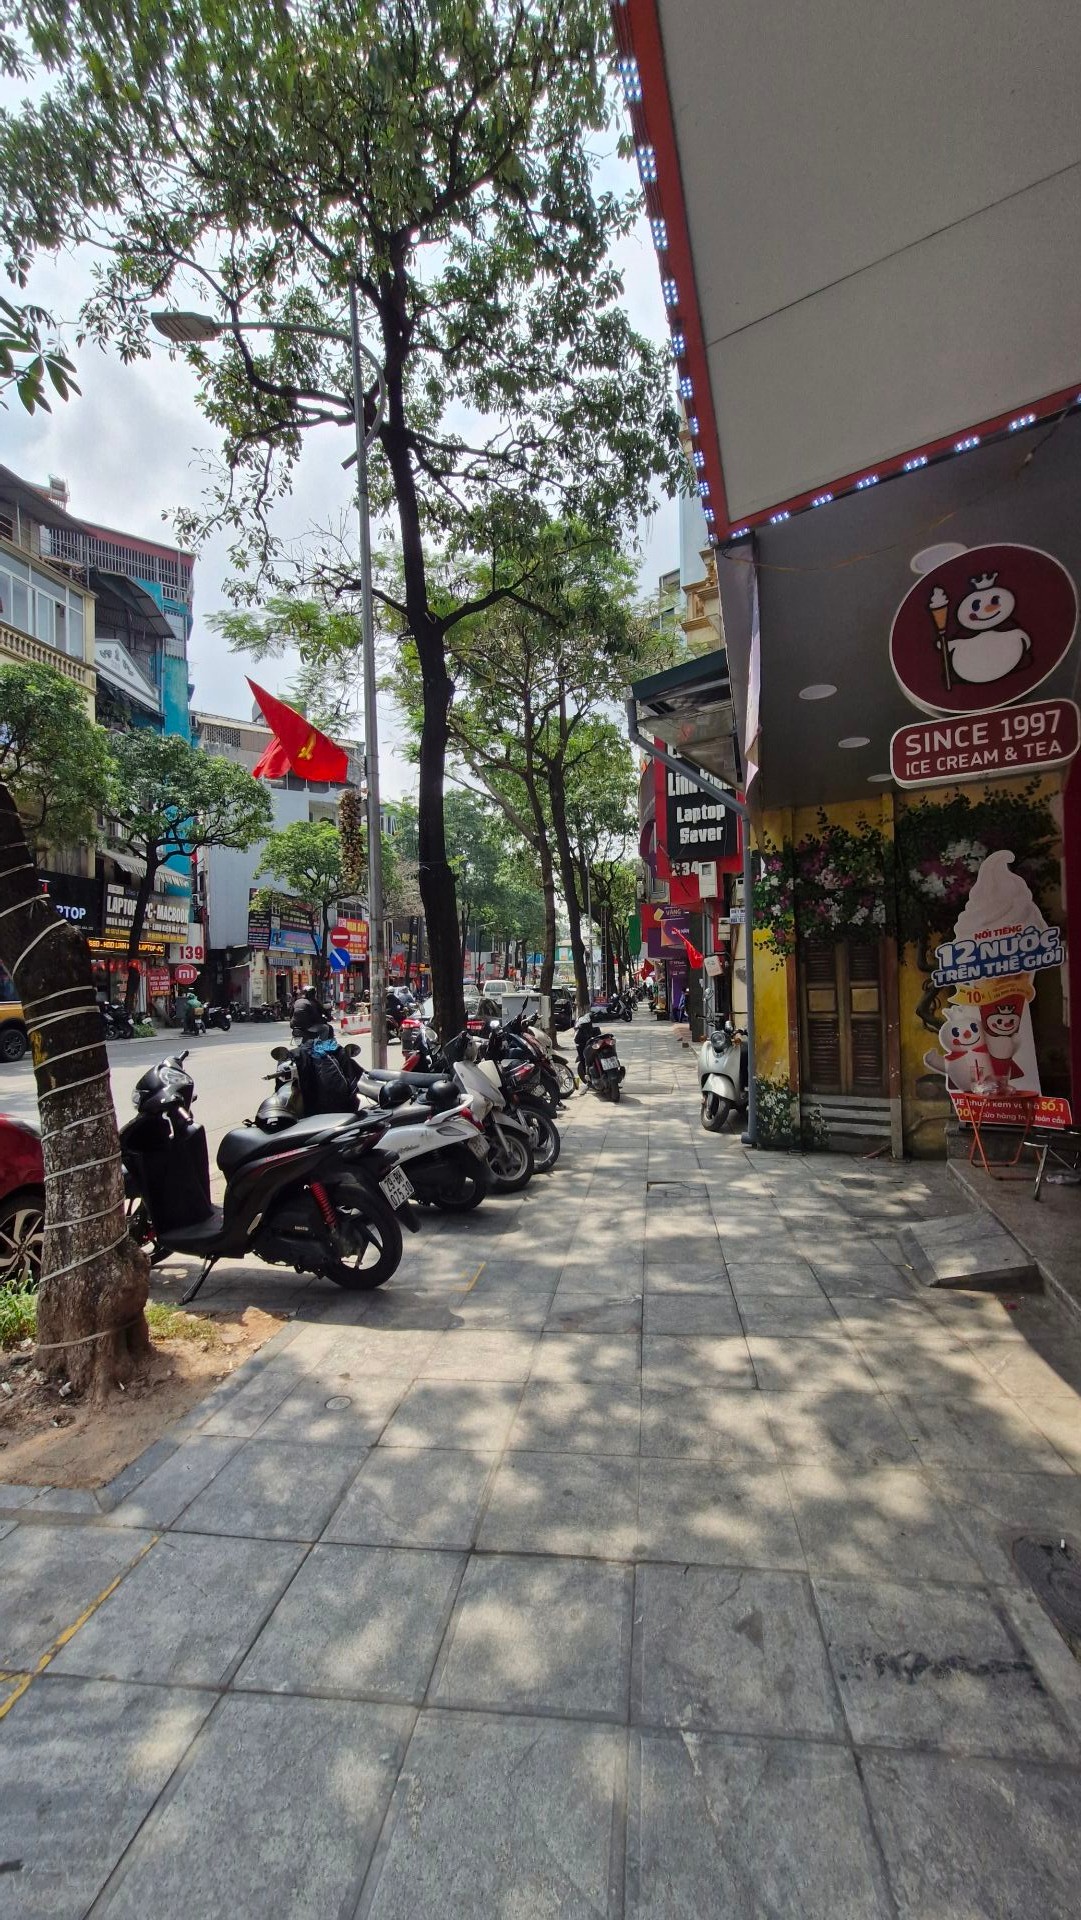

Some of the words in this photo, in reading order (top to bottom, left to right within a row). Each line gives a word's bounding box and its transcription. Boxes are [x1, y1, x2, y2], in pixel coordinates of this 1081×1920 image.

[905, 722, 989, 756] SINCE
[1000, 709, 1062, 742] 1997
[906, 759, 931, 776] ICE
[936, 749, 999, 771] CREAM
[1004, 746, 1018, 761] &
[1023, 739, 1063, 758] TEA
[677, 804, 725, 823] Laptop
[671, 861, 699, 877] 234
[156, 904, 189, 923] MACBOOK
[180, 945, 203, 960] 139
[938, 941, 977, 967] 12
[980, 926, 1058, 960] NƯỚC
[935, 964, 981, 983] TRÊN
[983, 952, 1025, 974] THẾ
[1023, 947, 1061, 968] GIỚI
[996, 1112, 1016, 1121] hàng
[1034, 1114, 1050, 1122] toàn
[1051, 1116, 1066, 1124] cầu
